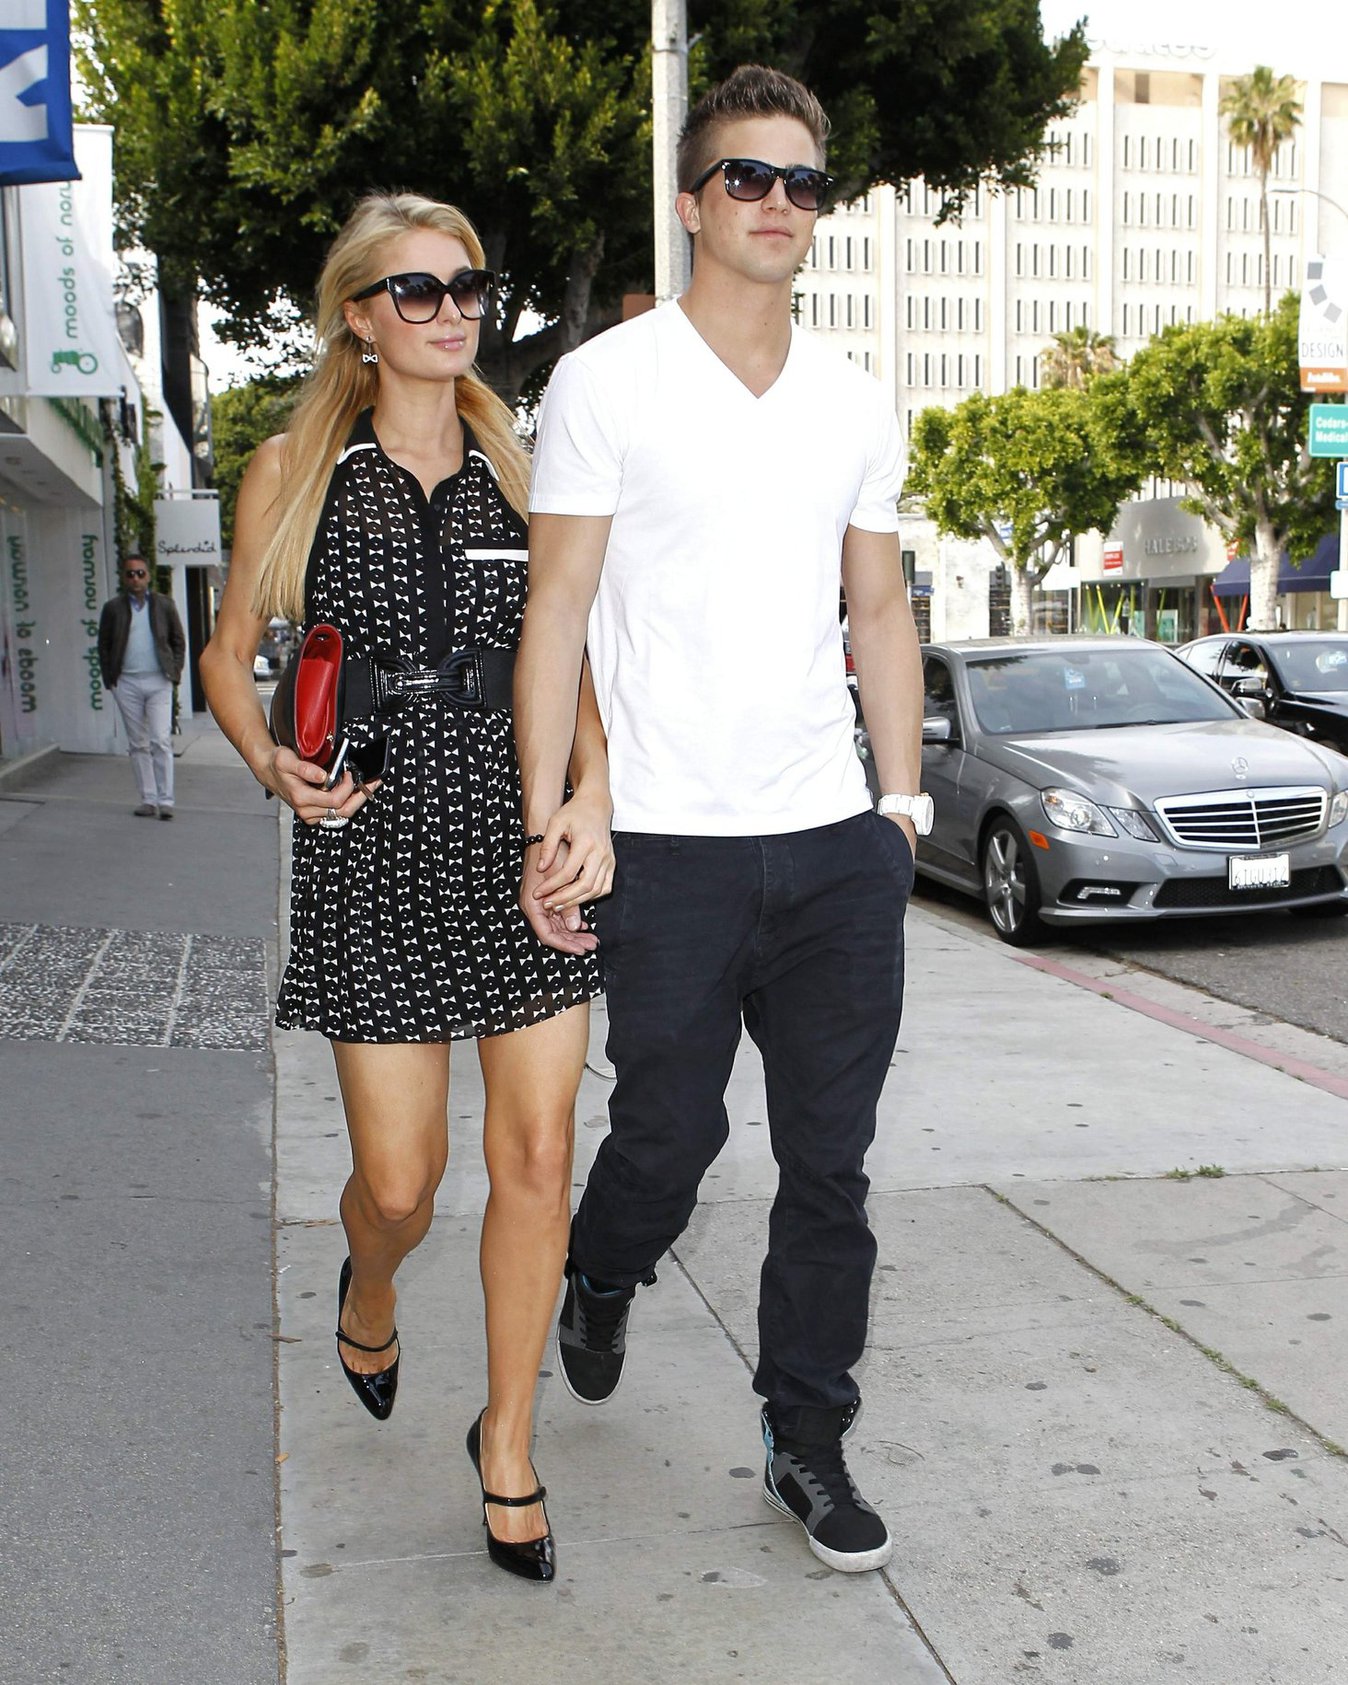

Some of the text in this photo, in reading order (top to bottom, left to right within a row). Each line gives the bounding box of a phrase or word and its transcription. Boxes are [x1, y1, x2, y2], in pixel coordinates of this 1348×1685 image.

[55, 236, 74, 257] of
[57, 267, 78, 339] moods
[1301, 341, 1344, 359] DESIGN
[157, 540, 217, 557] Splendid
[80, 534, 103, 711] moods of norway
